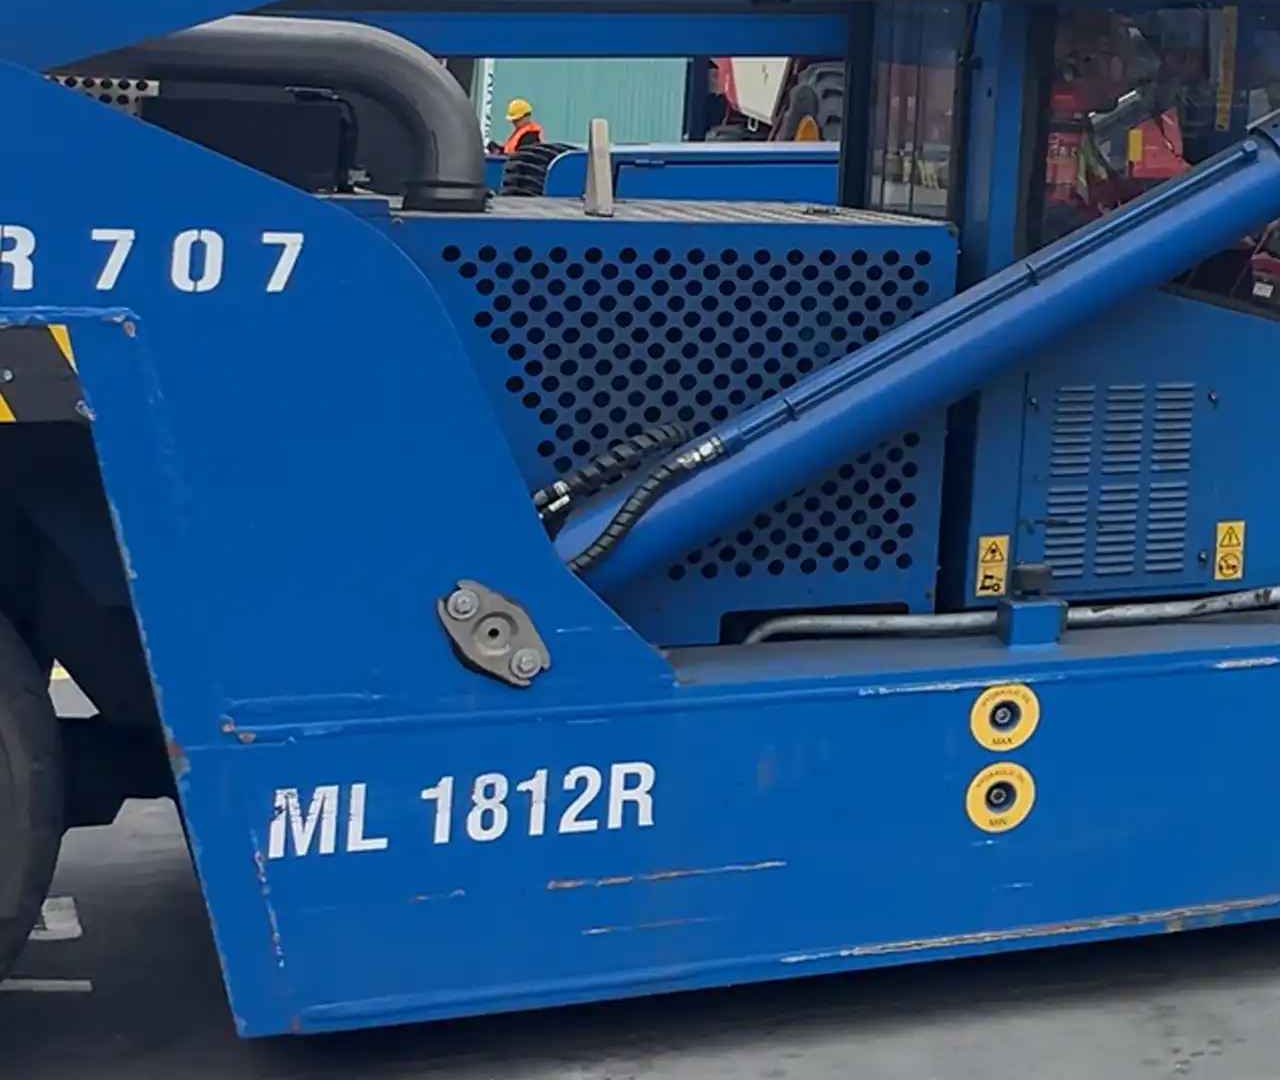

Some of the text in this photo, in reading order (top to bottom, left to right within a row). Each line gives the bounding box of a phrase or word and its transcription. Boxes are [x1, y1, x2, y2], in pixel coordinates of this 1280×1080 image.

[992, 737, 1013, 746] MAX
[270, 761, 657, 860] ML 1812R
